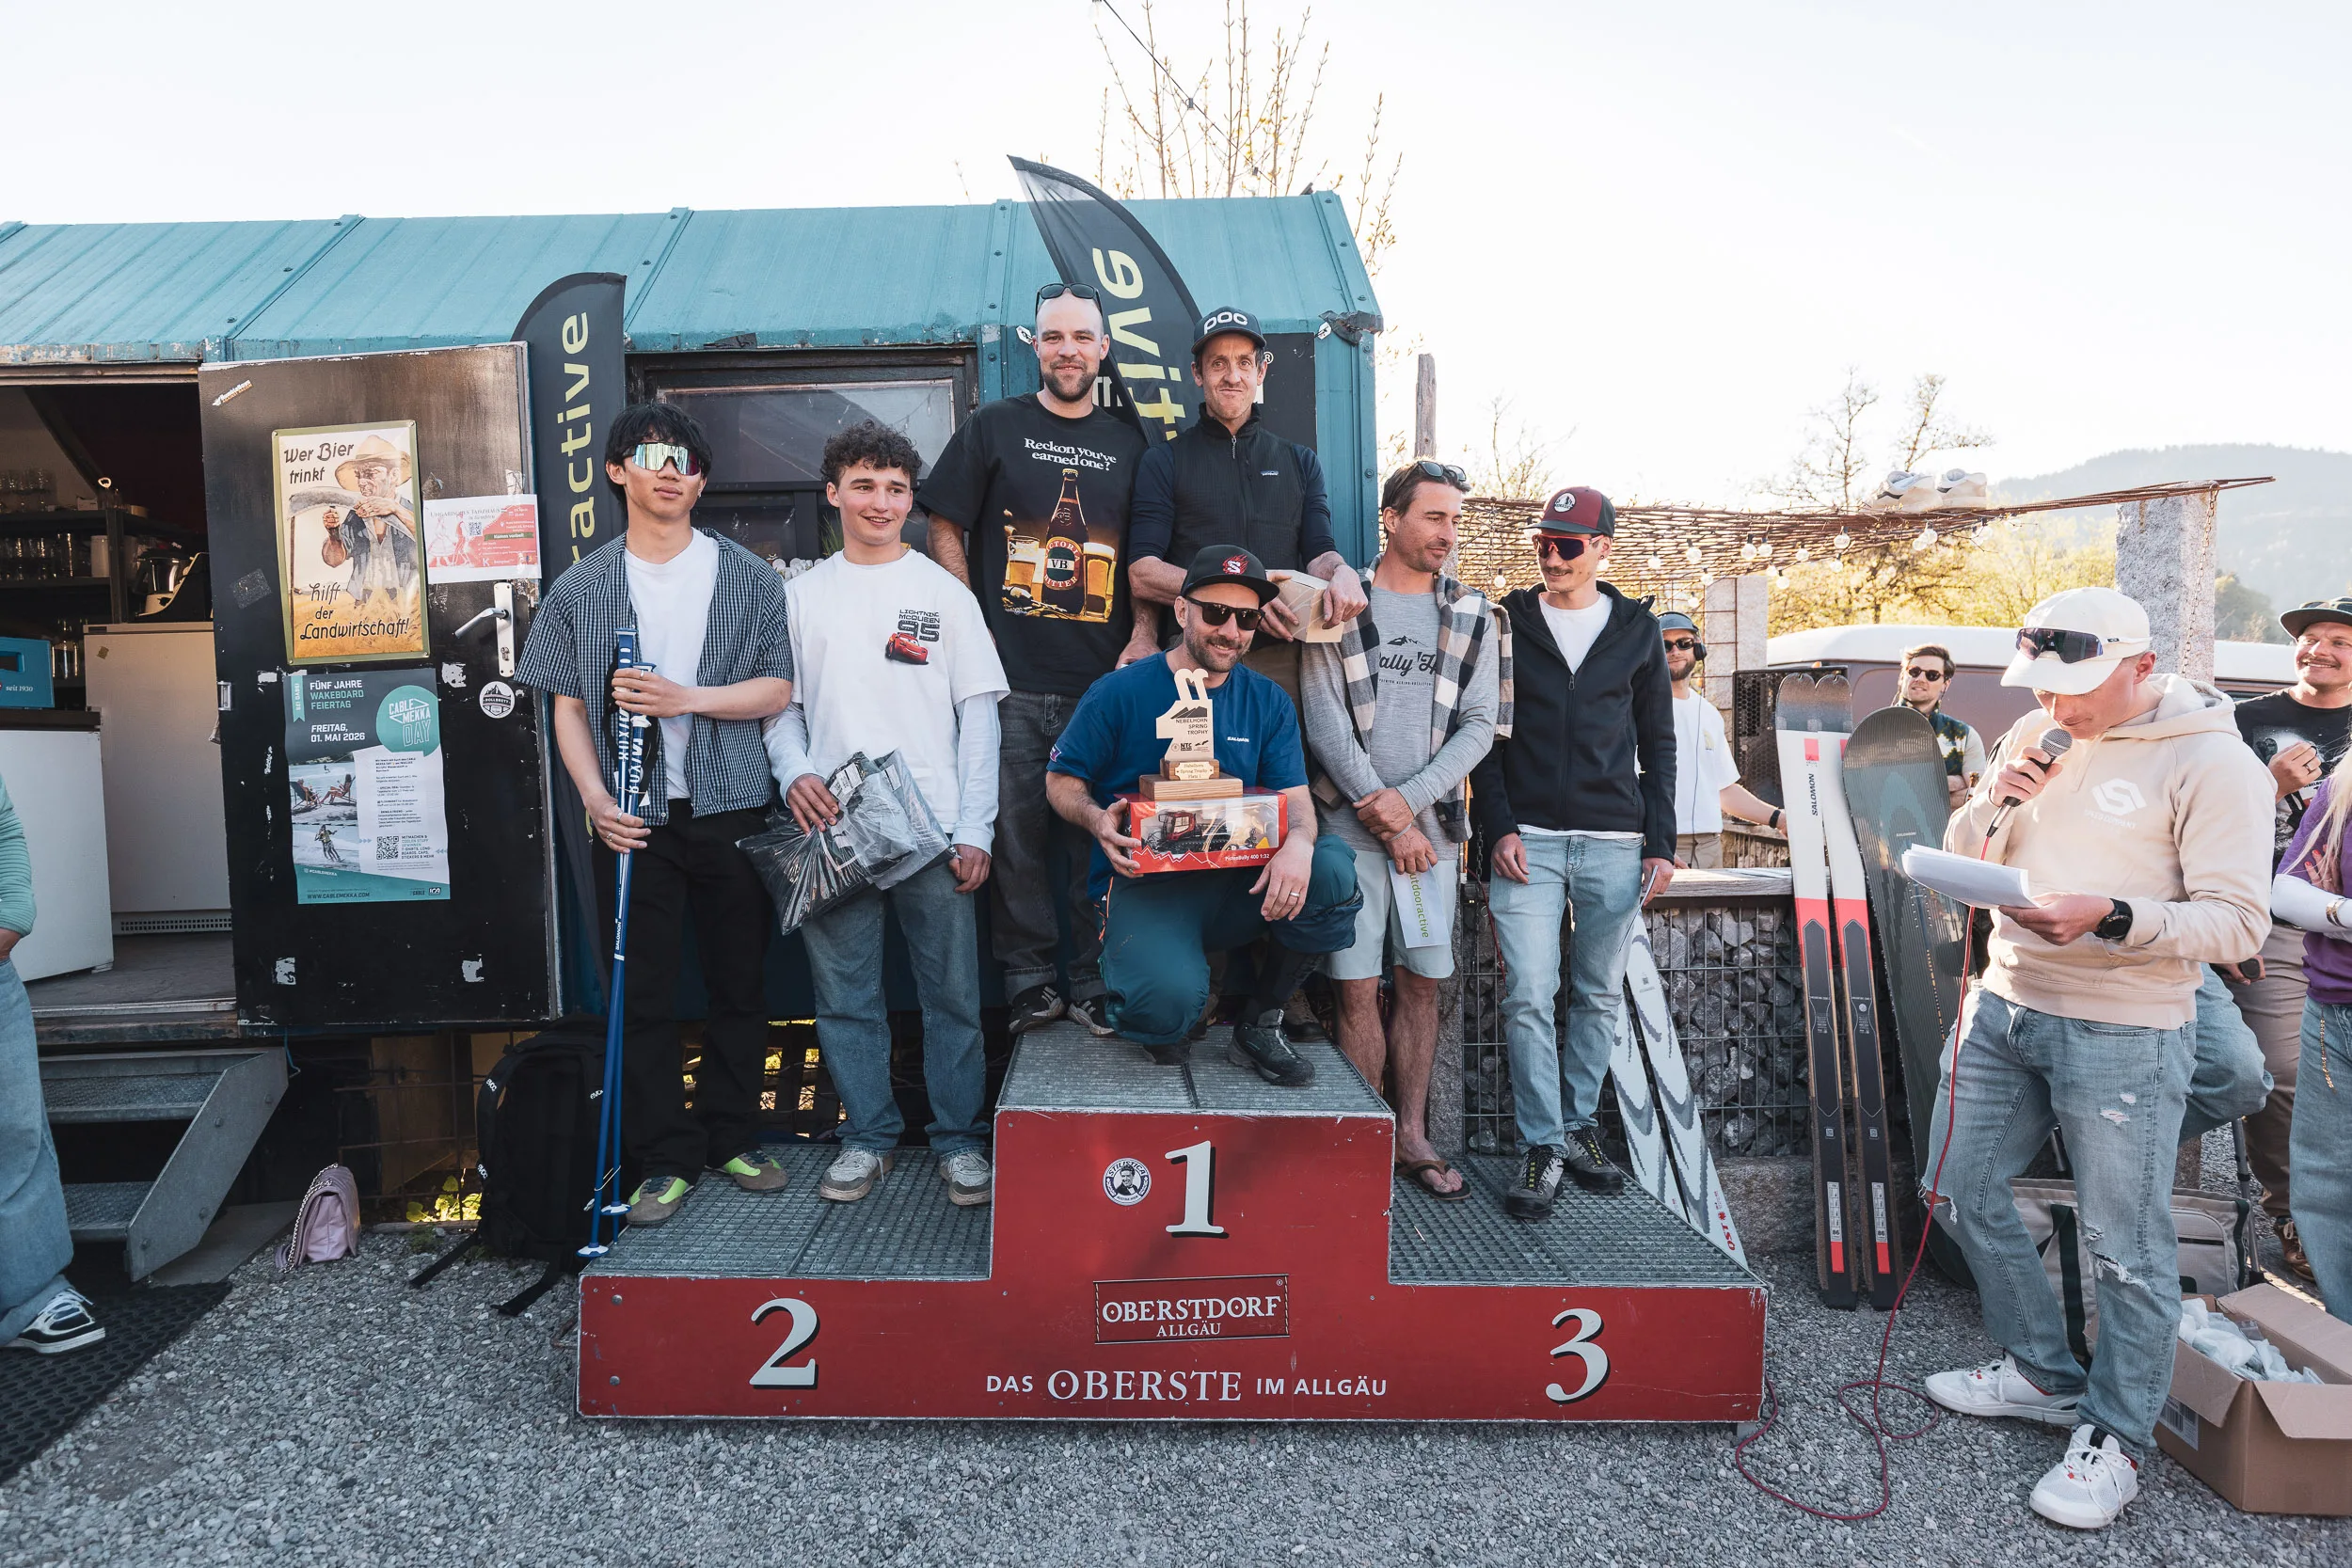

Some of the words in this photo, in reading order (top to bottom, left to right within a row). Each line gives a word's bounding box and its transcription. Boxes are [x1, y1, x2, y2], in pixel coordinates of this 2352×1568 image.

[284, 448, 314, 463] Wer
[317, 442, 355, 461] Bier
[1024, 437, 1075, 454] Reckon
[1077, 447, 1117, 463] you've
[1031, 451, 1079, 466] earned
[290, 467, 326, 484] trinkt
[1052, 560, 1068, 569] VB
[310, 582, 341, 605] hilft
[315, 606, 334, 620] der
[300, 618, 409, 640] Landwirtschaft!
[898, 620, 940, 642] 95
[1378, 652, 1413, 677] ally
[310, 680, 332, 690] FÜNF
[334, 679, 363, 689] JAHRE
[310, 689, 364, 700] WAKEBOARD
[310, 700, 352, 710] FEIERTAG
[389, 698, 415, 715] CABLE
[402, 707, 431, 723] MEKKA
[310, 734, 323, 742] 01.
[325, 733, 342, 741] MAI
[342, 732, 366, 741] 2026
[311, 723, 348, 733] FREITAG,
[403, 719, 431, 747] DAY
[1808, 773, 1819, 816] SALOMON
[1109, 1161, 1146, 1177] STILISTICA
[1164, 1140, 1226, 1238] 1
[1103, 1295, 1281, 1323] OBERSTDORF
[1156, 1321, 1222, 1338] ALLGÄU
[749, 1298, 818, 1388] 2
[1545, 1307, 1610, 1404] 3
[986, 1374, 1034, 1393] DAS
[1046, 1370, 1243, 1402] OBERSTE
[1256, 1377, 1285, 1396] IM
[1294, 1374, 1388, 1397] ALLGÄU
